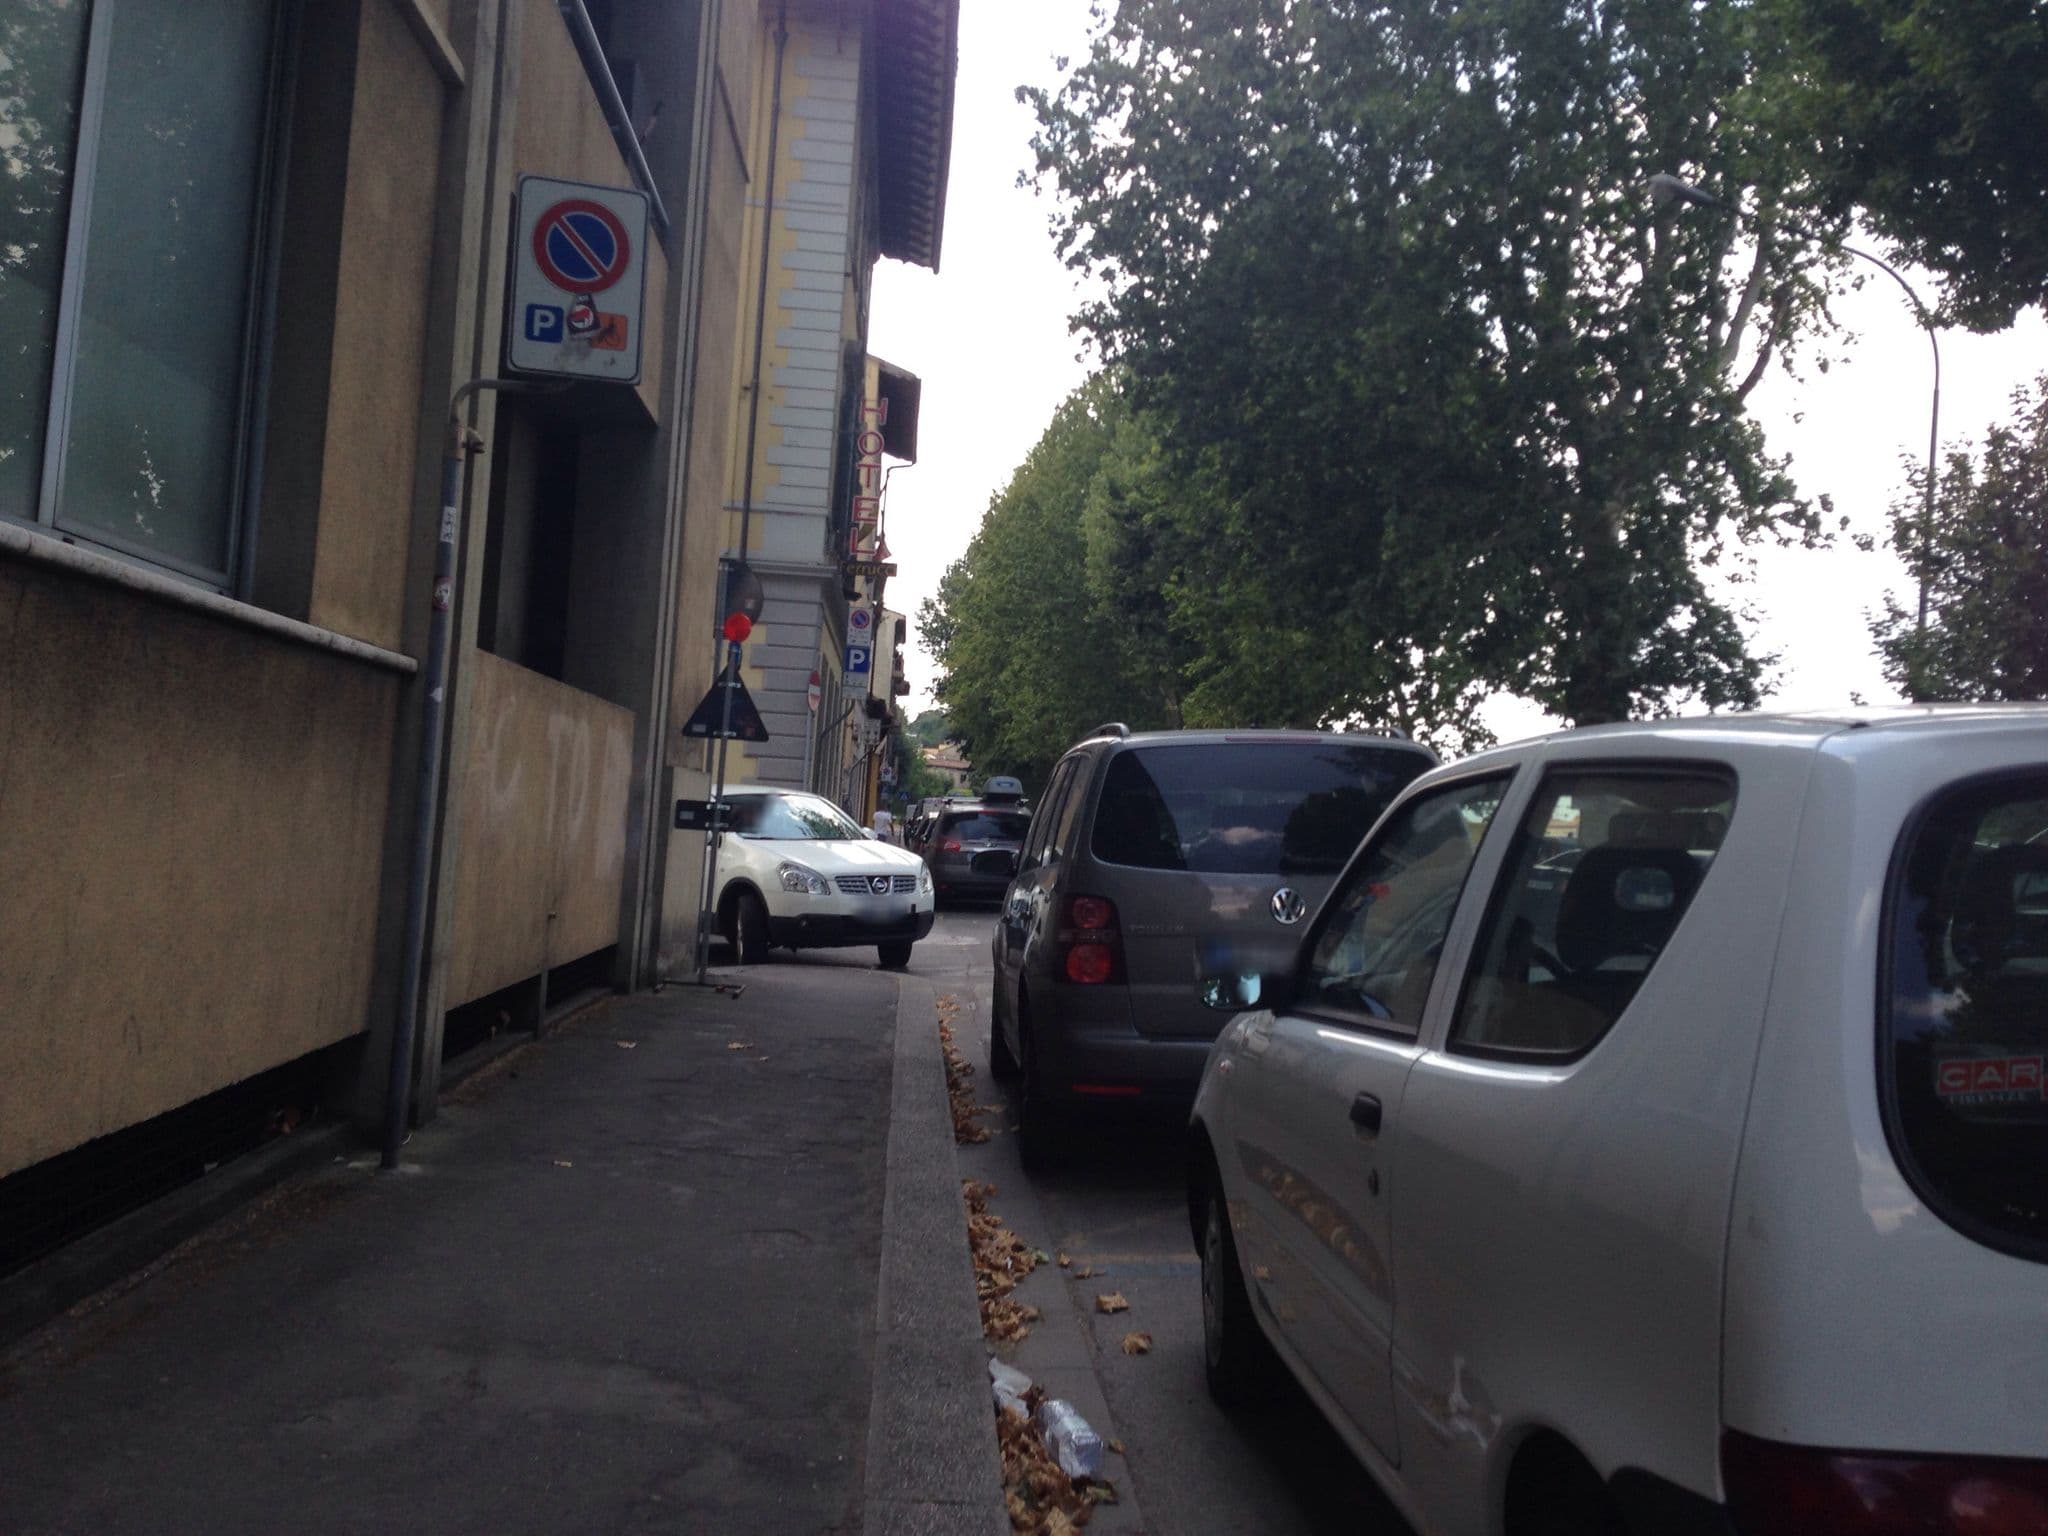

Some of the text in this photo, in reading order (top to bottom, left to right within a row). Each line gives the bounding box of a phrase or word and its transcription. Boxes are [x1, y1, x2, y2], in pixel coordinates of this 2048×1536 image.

[533, 309, 556, 337] P
[850, 397, 888, 555] HOTEL
[849, 649, 866, 670] P
[1943, 1062, 2038, 1087] CAR
